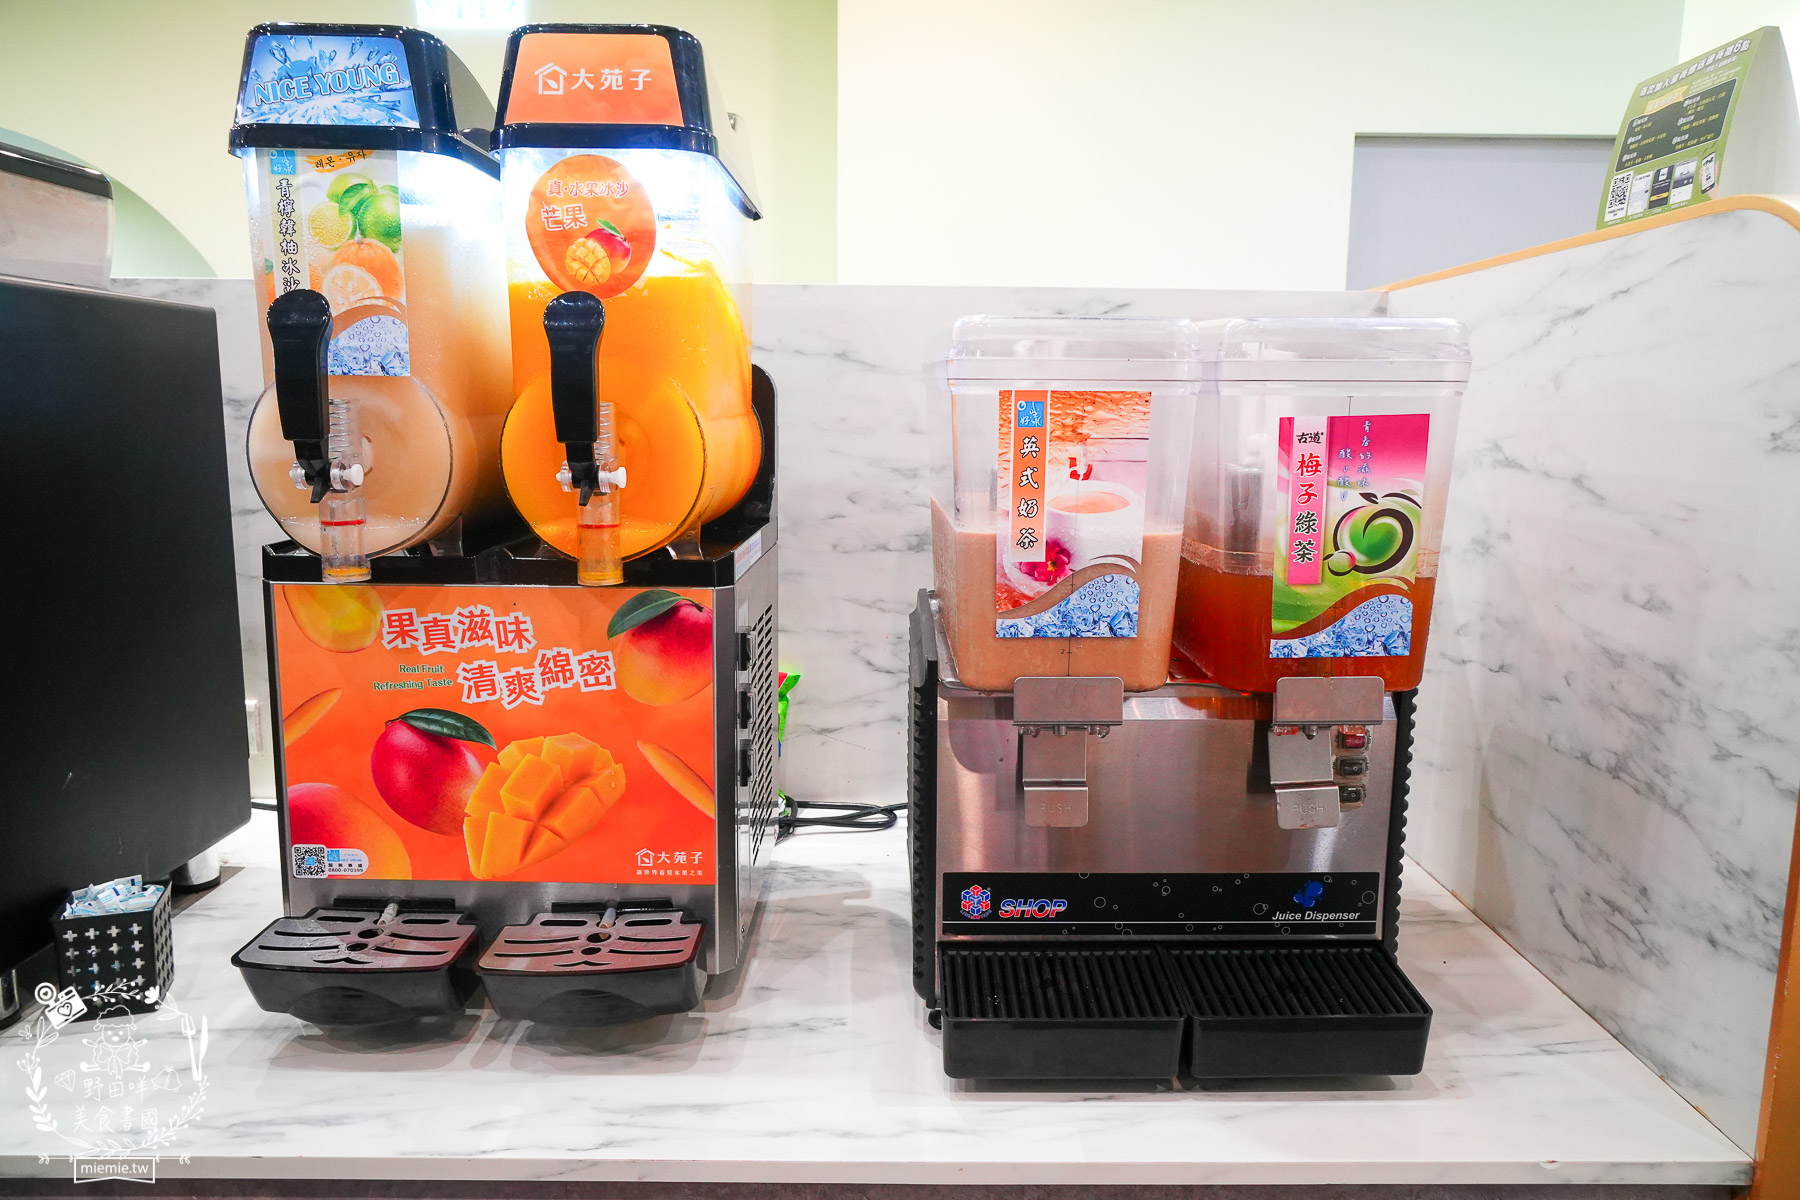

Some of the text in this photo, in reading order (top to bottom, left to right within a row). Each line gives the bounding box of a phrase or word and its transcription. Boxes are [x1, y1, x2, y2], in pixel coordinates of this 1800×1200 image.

[254, 62, 400, 106] NICE YOUNG
[570, 68, 652, 91] 大苑子
[541, 203, 588, 232] 芒果
[1017, 435, 1041, 550] 英式奶茶
[1292, 452, 1323, 563] 梅子綠茶
[381, 604, 537, 656] 果真滋味
[399, 664, 445, 674] Real Fruit
[457, 646, 617, 710] 清爽綿密
[373, 677, 453, 692] Refreshing Taste
[1040, 803, 1072, 814] PUSH
[1292, 803, 1324, 815] PUSH
[657, 851, 703, 864] 大苑子
[999, 898, 1068, 918] SHOP
[1272, 910, 1361, 922] Juice Dispenser
